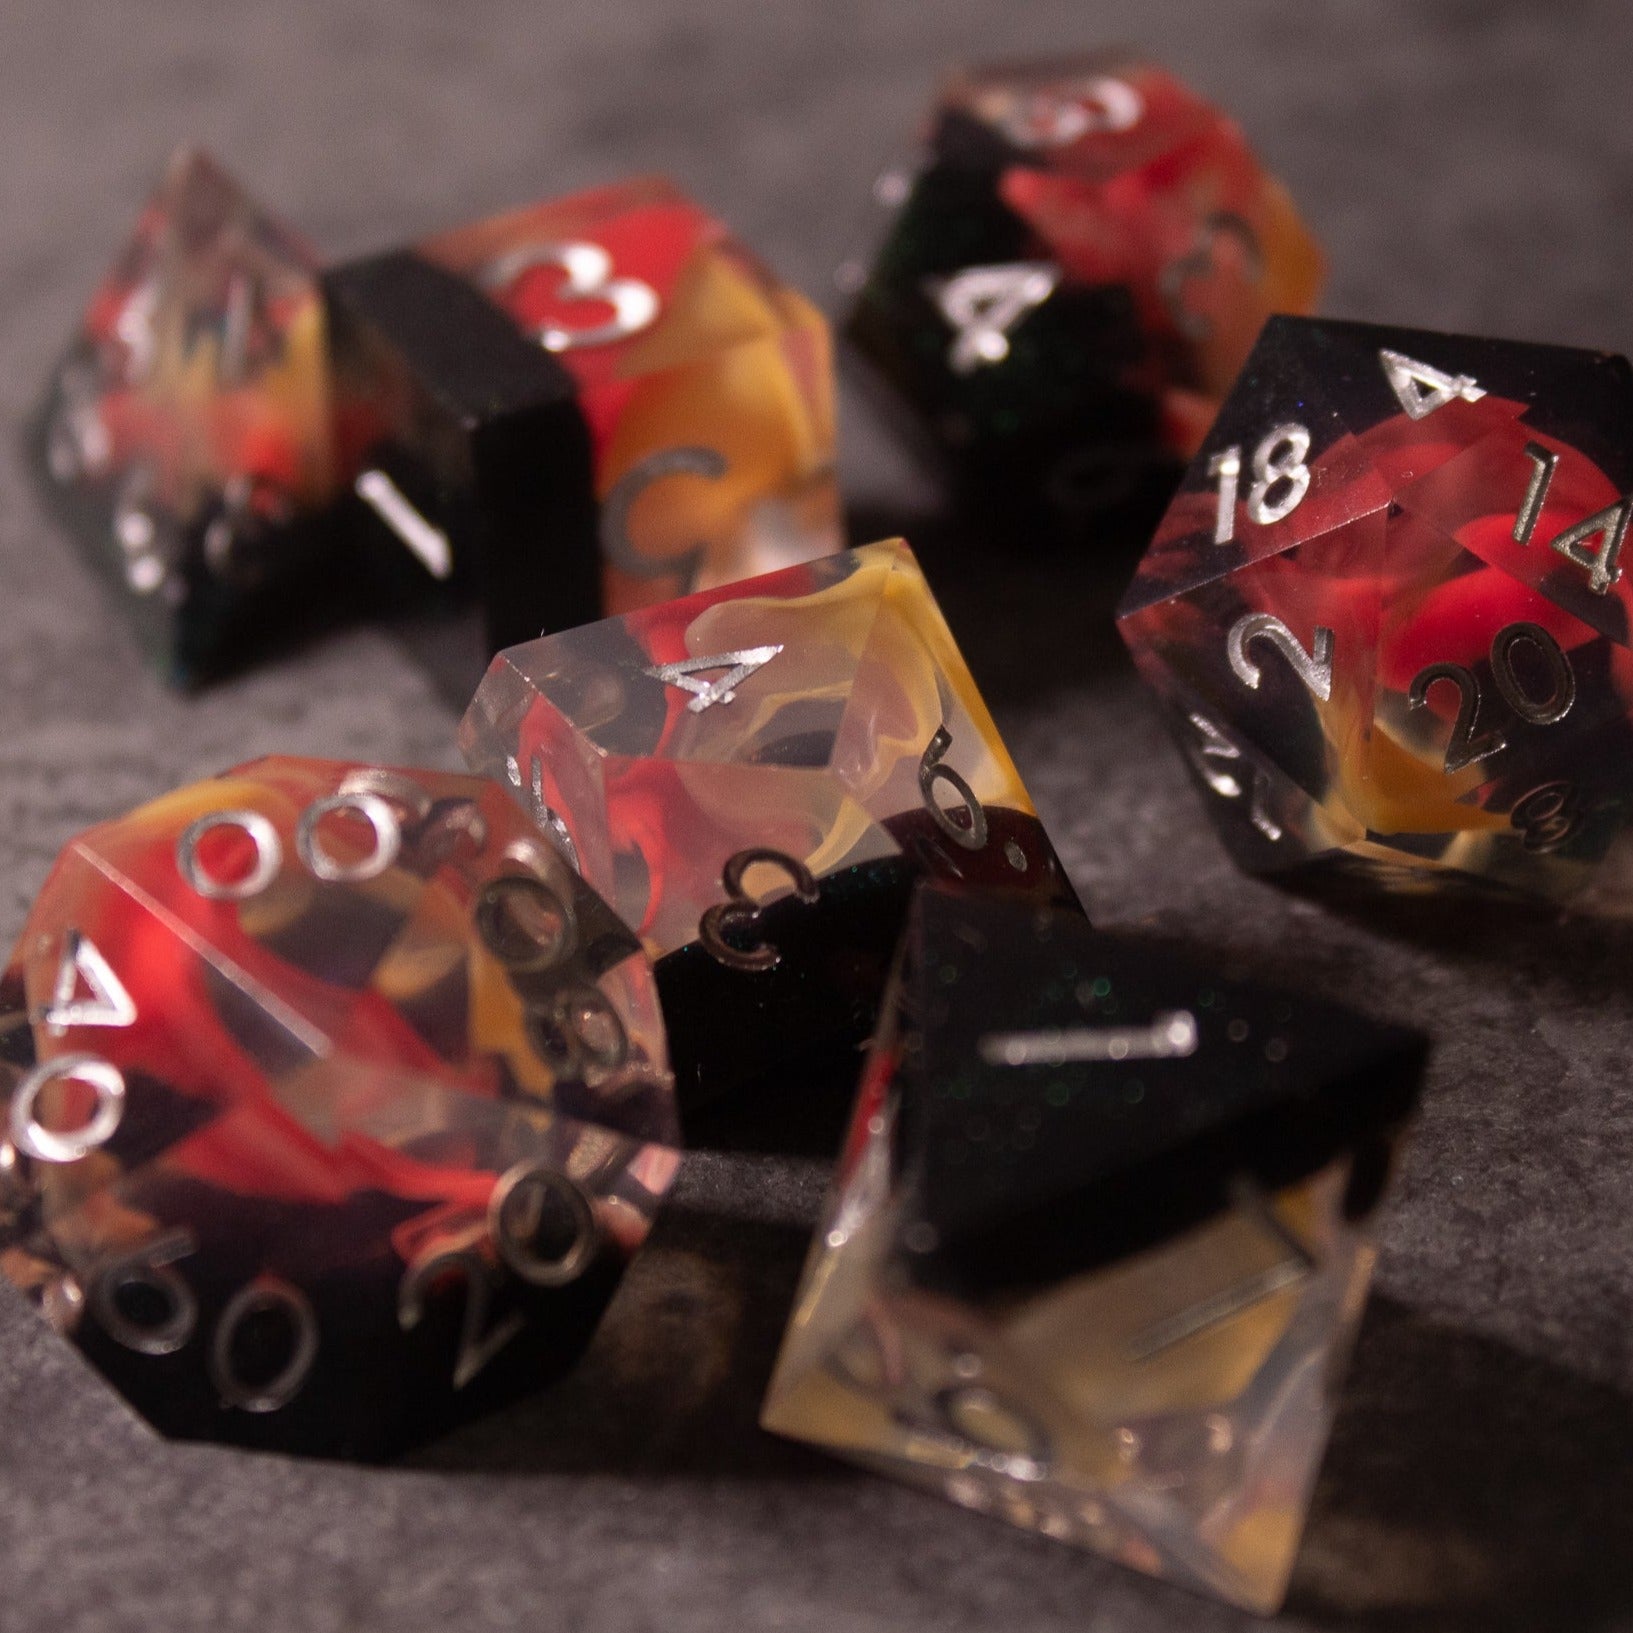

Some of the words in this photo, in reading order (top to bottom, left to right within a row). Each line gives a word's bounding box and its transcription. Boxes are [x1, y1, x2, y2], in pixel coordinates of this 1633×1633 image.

[488, 242, 660, 352] 3
[1380, 348, 1487, 420] 4
[1206, 423, 1311, 545] 18
[1511, 440, 1632, 596] 14
[645, 644, 784, 712] 4
[1227, 612, 1335, 702] 2
[1409, 621, 1577, 775] 20
[177, 792, 404, 900] 00
[698, 848, 820, 972] 3
[10, 930, 138, 1162] 40
[399, 1160, 596, 1391] 20
